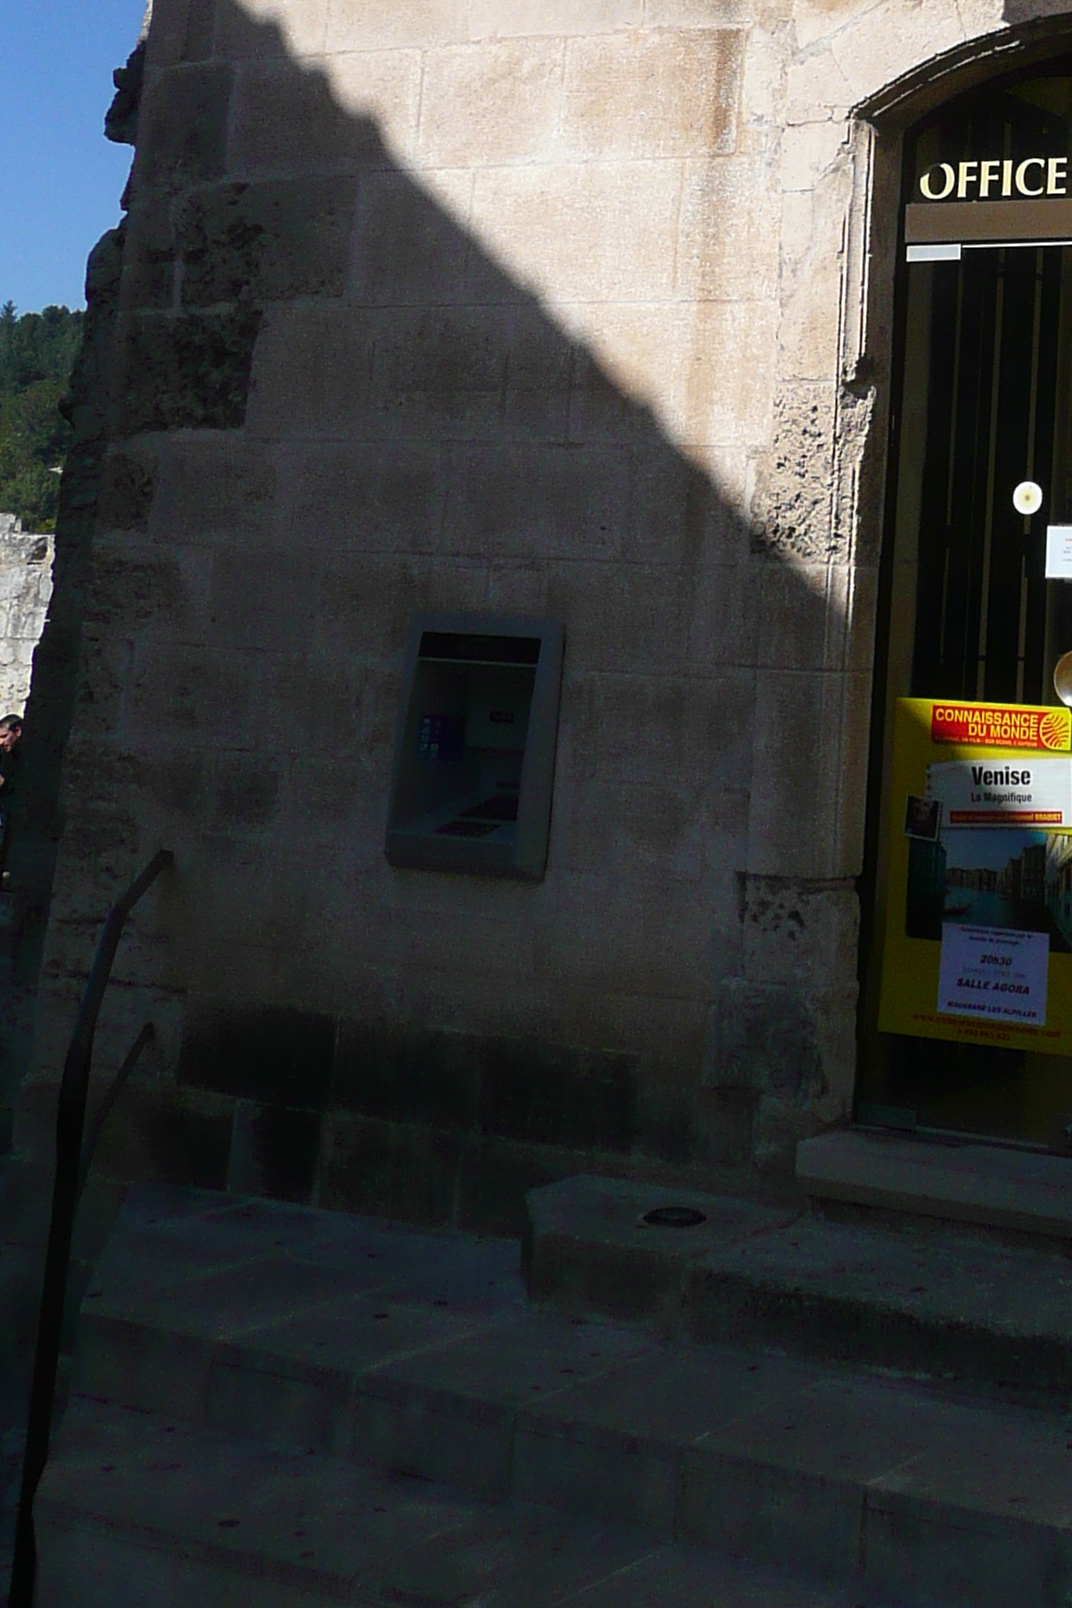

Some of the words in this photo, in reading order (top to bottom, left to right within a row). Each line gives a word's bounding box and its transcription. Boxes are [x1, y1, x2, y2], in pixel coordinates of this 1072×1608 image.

[919, 156, 1068, 200] OFFICE
[935, 708, 1039, 728] CONNAISSANCE
[968, 723, 987, 737] DU
[990, 725, 1038, 741] MONDE
[971, 765, 1031, 786] Venise
[971, 792, 981, 803] La
[984, 792, 1032, 805] Magnifique
[980, 954, 1012, 966] 20h30
[956, 977, 990, 990] SALLE
[992, 982, 1030, 995] AGORA
